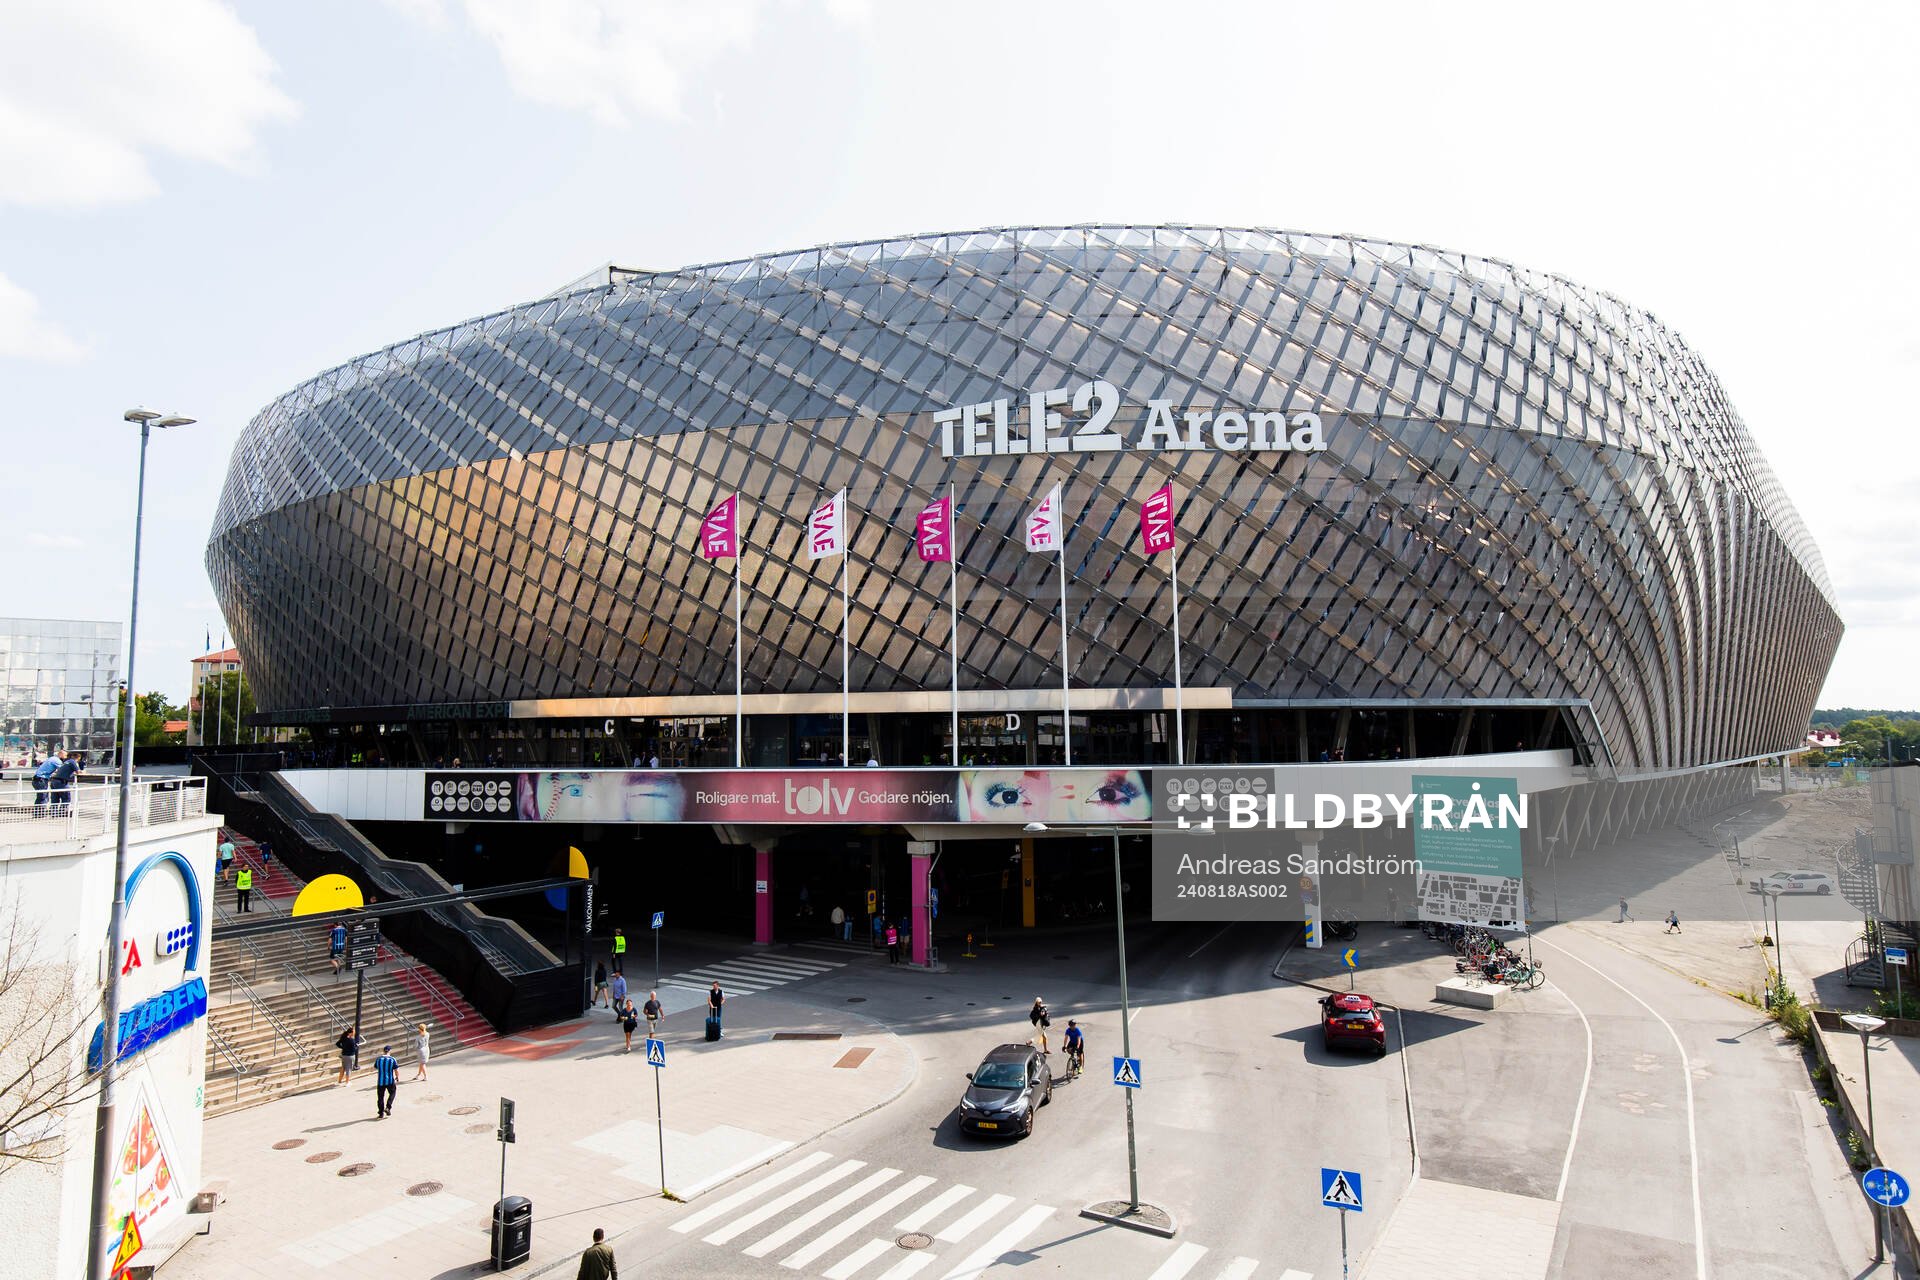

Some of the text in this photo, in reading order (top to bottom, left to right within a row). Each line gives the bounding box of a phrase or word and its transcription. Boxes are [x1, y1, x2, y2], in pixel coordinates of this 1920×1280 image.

[934, 381, 1327, 458] TELE2 Arena
[407, 705, 472, 720] AMERICAN
[604, 719, 615, 736] C
[1005, 713, 1021, 732] D
[696, 778, 953, 815] Roligare mat. tolv Godare nöjen.
